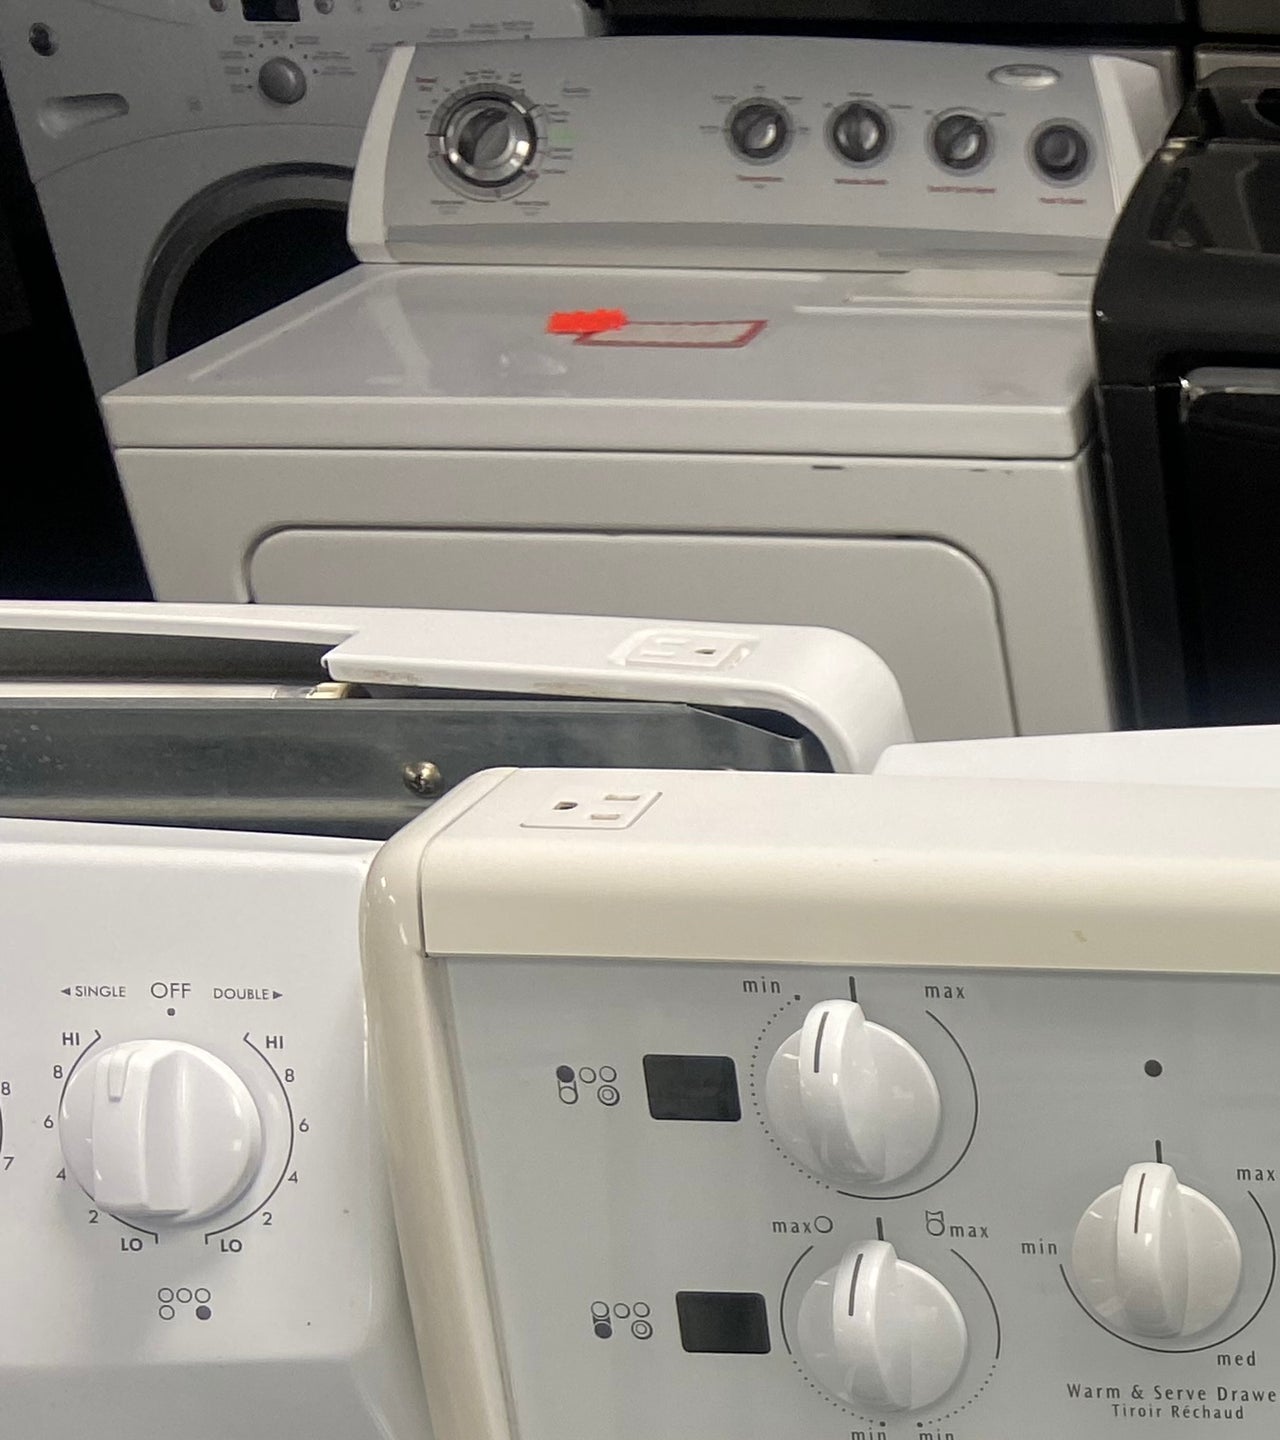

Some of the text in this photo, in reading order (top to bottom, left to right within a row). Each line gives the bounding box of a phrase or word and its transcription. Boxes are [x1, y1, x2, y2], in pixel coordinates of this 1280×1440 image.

[75, 985, 126, 998] SINGLE
[150, 981, 192, 999] OFF
[742, 975, 781, 994] min
[213, 987, 270, 1001] DOUBLE
[924, 985, 966, 1000] max
[62, 1031, 80, 1046] HI
[265, 1035, 284, 1050] HI
[53, 1064, 64, 1080] 8
[284, 1068, 295, 1083] 8
[1, 1081, 11, 1096] 8
[43, 1114, 54, 1129] 6
[298, 1117, 310, 1133] 6
[3, 1156, 15, 1171] 7
[55, 1167, 67, 1181] 4
[287, 1170, 299, 1184] 4
[1236, 1168, 1276, 1182] max
[88, 1209, 99, 1224] 2
[262, 1211, 273, 1226] 2
[772, 1221, 812, 1234] max
[949, 1225, 989, 1239] max
[120, 1237, 143, 1252] LO
[220, 1238, 243, 1253] LO
[1021, 1238, 1058, 1256] min
[1217, 1350, 1256, 1367] med
[1066, 1383, 1121, 1399] Warm
[1130, 1384, 1145, 1400] &
[1153, 1384, 1207, 1401] Serve
[1111, 1403, 1244, 1420] Tiroir Réchaud
